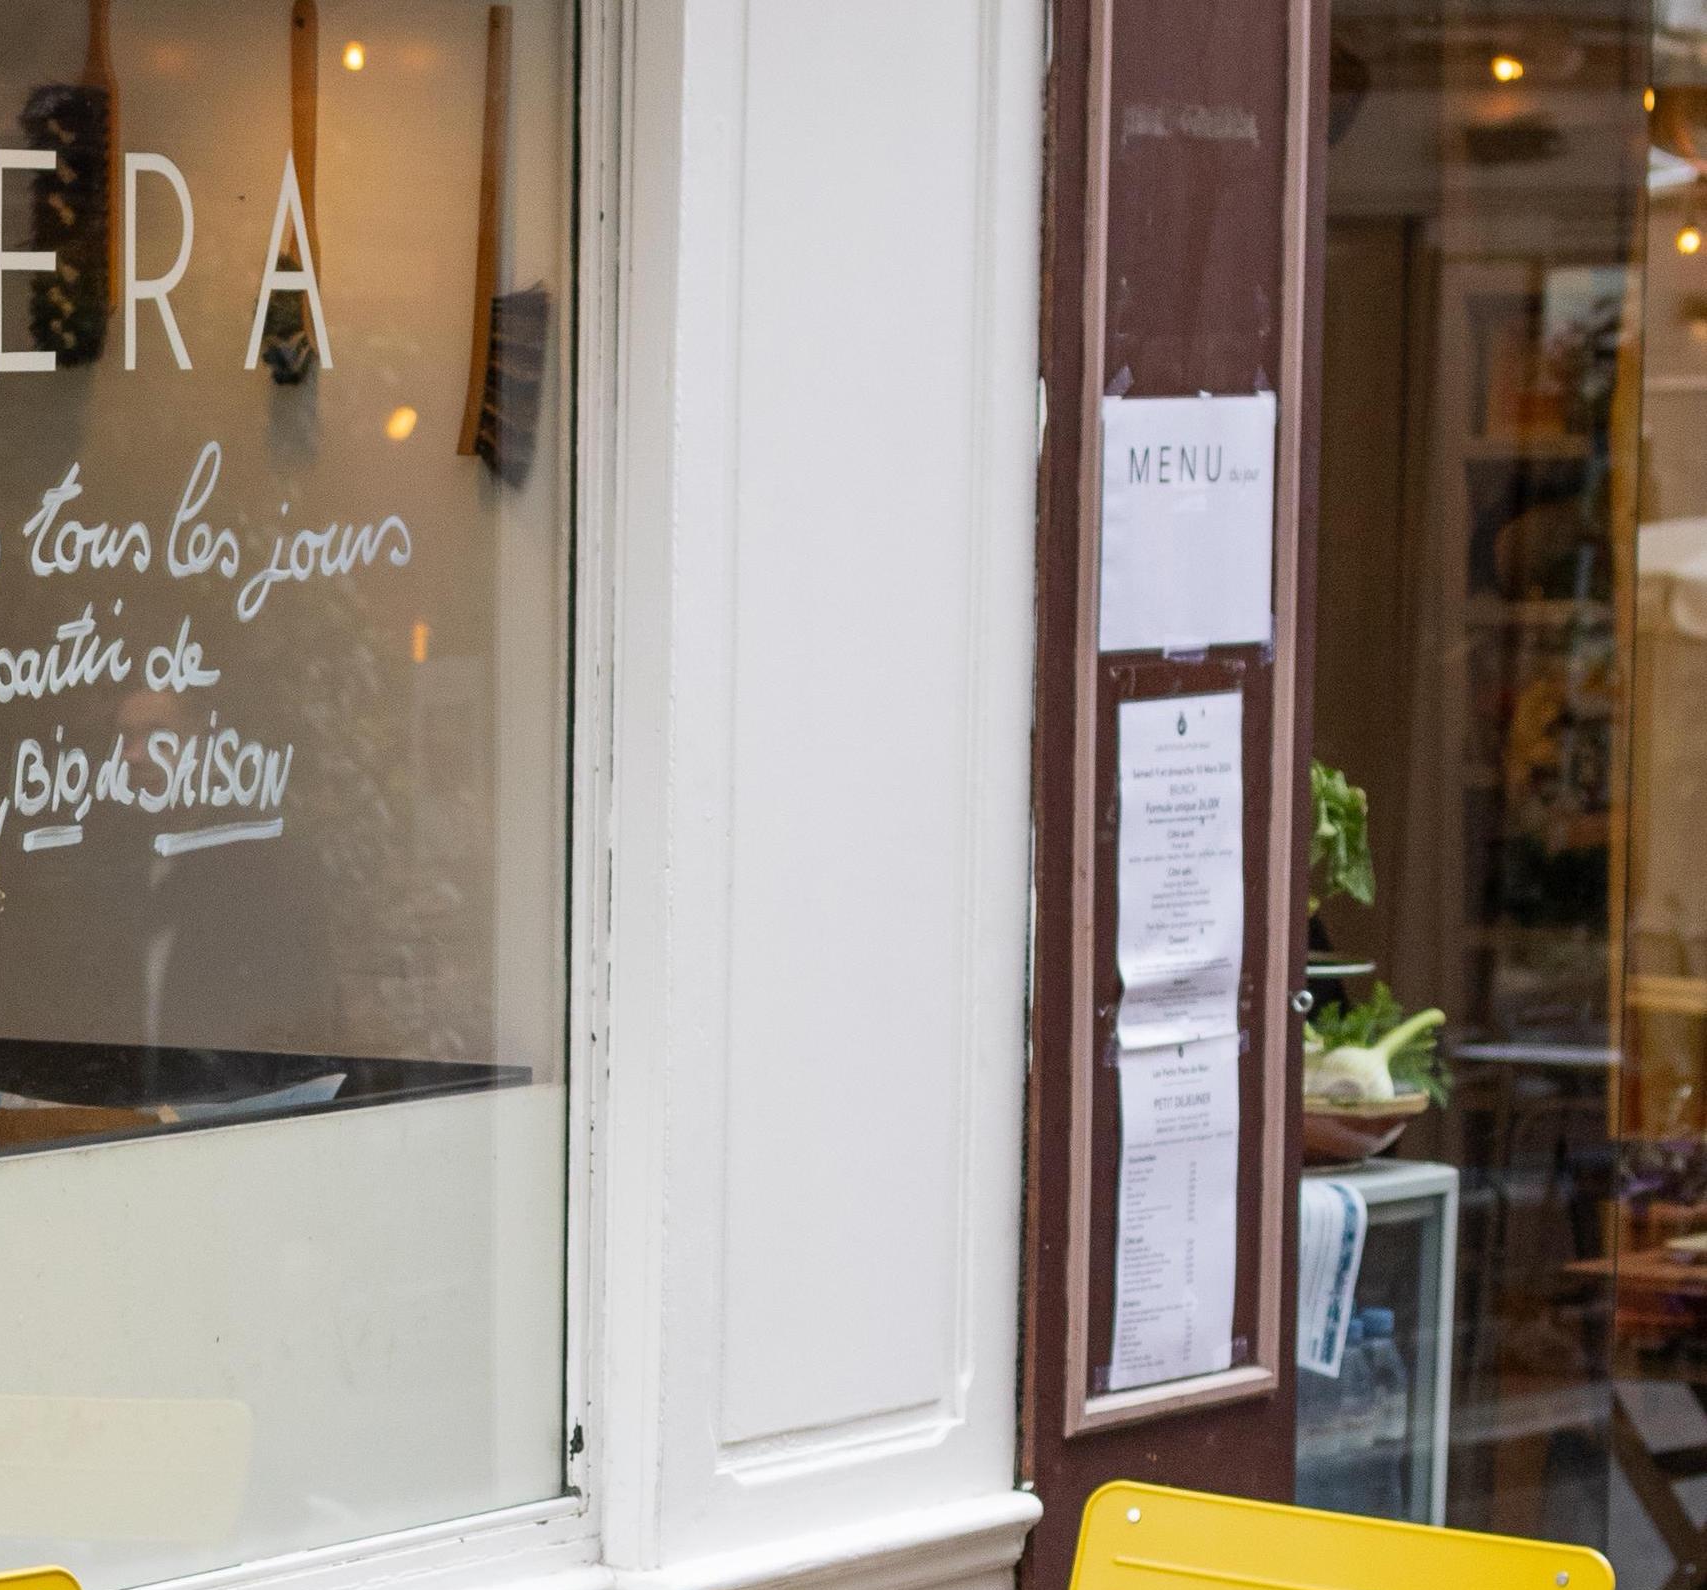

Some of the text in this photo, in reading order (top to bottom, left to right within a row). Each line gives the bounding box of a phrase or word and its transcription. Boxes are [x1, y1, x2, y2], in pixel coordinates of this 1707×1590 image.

[1129, 445, 1222, 484] MENU
[24, 462, 152, 576] tous
[168, 440, 240, 578] les
[237, 502, 412, 622] jours
[145, 616, 220, 692] de
